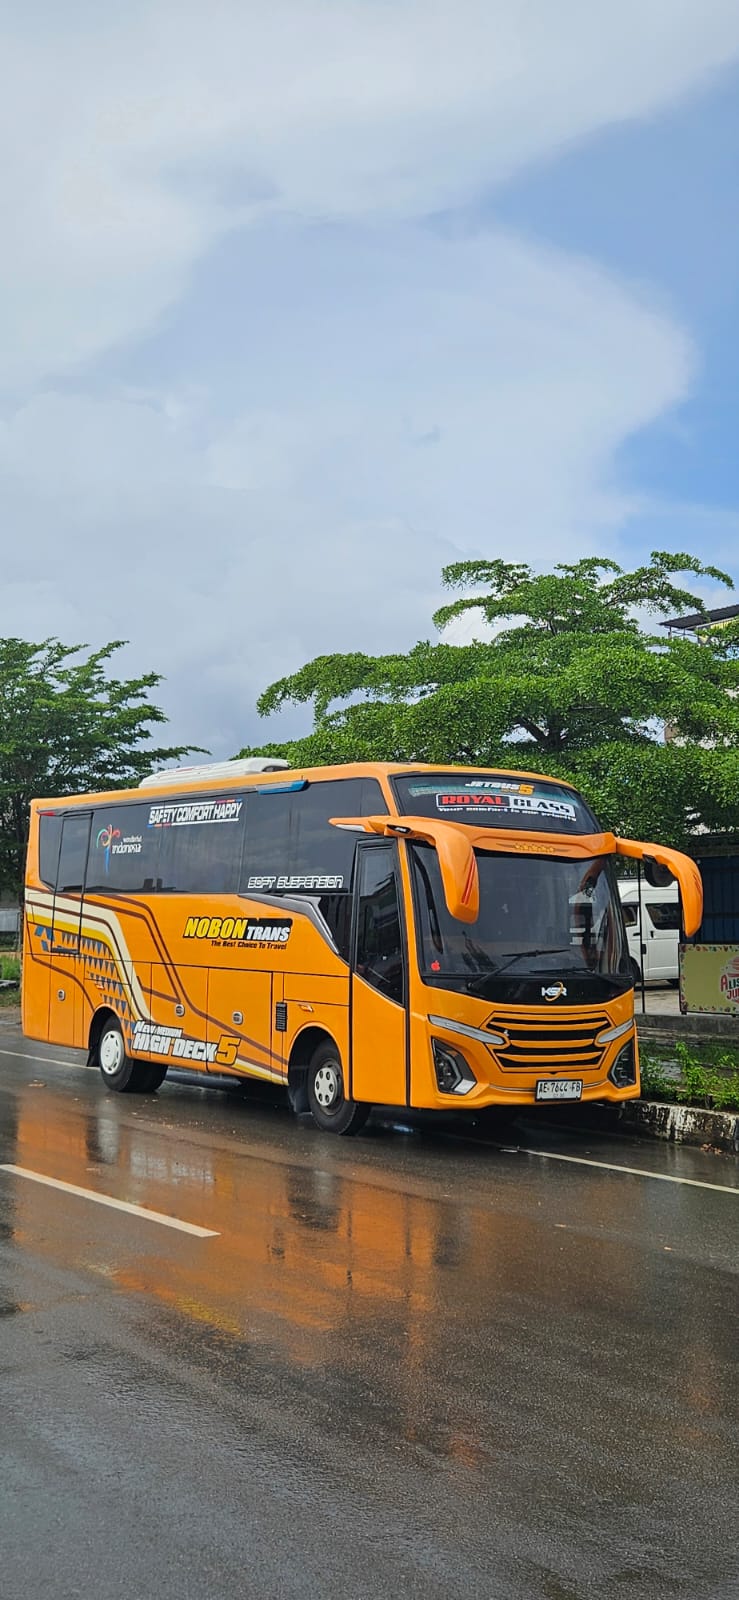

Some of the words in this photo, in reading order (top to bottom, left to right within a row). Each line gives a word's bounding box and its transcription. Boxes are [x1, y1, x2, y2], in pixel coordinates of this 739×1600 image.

[149, 810, 177, 823] SAFETY
[176, 805, 214, 821] COMFORT
[213, 801, 242, 818] HAPPY
[441, 795, 507, 805] ROYAL
[514, 798, 570, 813] CLASS
[248, 877, 276, 888] SOFT
[277, 876, 343, 888] SUSPENSION
[184, 918, 248, 939] NOBON
[247, 926, 290, 941] TRANS
[266, 942, 287, 950] Travel
[132, 1032, 172, 1055] HIGH
[172, 1038, 218, 1063] DECK
[215, 1035, 241, 1066] 5
